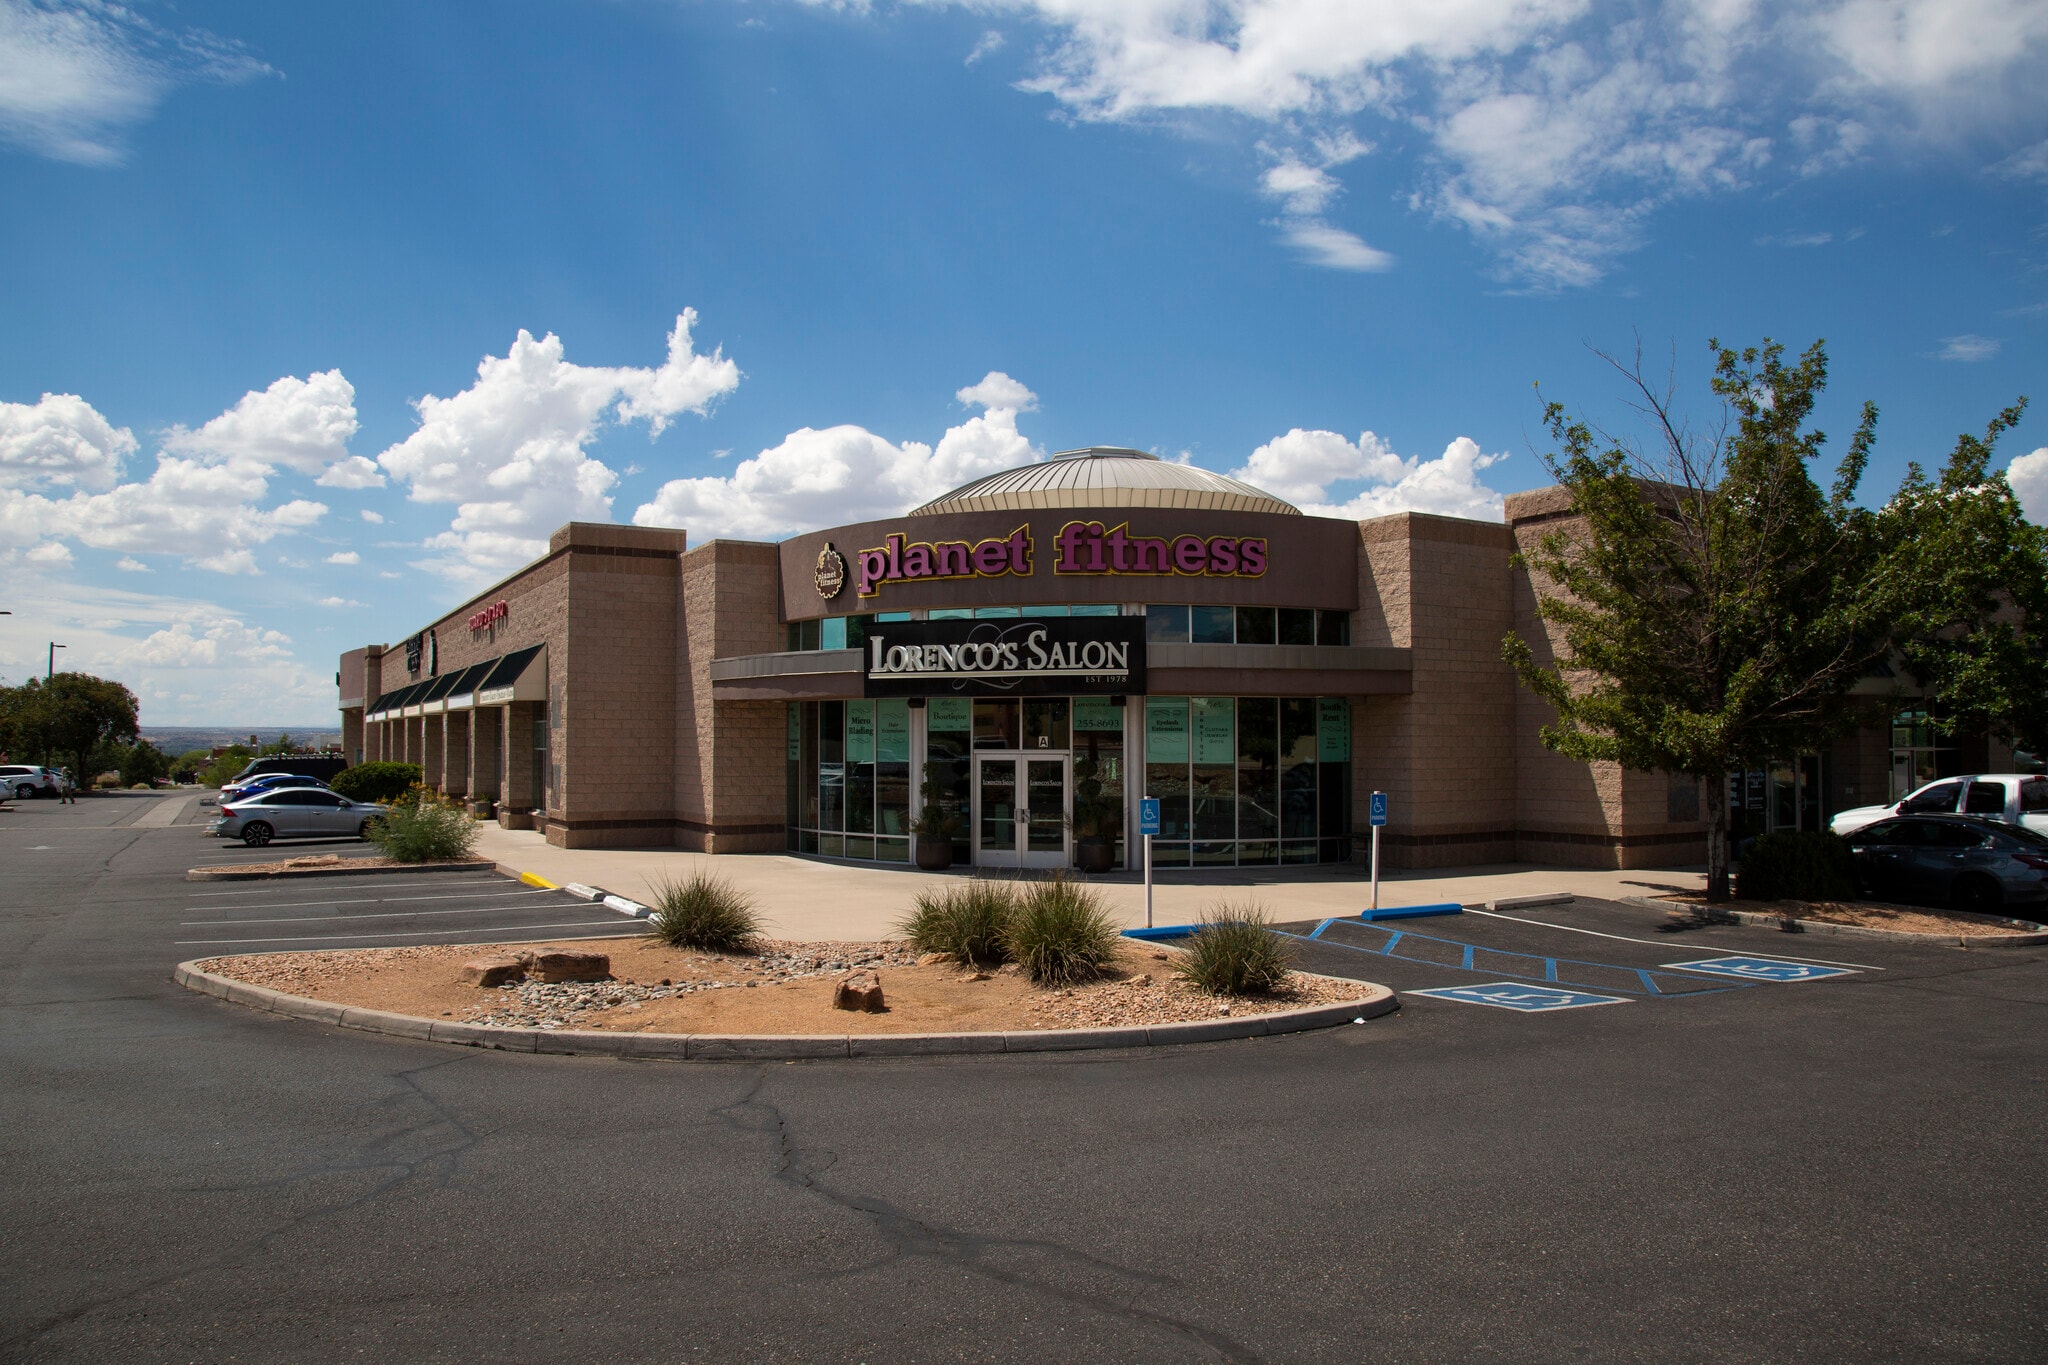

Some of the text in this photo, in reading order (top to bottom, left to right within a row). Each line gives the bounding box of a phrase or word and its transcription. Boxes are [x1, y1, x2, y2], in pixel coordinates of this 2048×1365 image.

[858, 522, 1267, 596] planet fitness
[817, 570, 837, 582] planet
[820, 578, 841, 587] fitness
[870, 630, 1129, 672] LORENCO'S SALON
[1085, 675, 1127, 683] EST 1978
[1320, 703, 1341, 712] Booth
[933, 712, 967, 721] Boutique
[1322, 714, 1340, 722] Rent
[1076, 719, 1120, 728] 255-8693
[848, 726, 873, 736] Blading
[1040, 737, 1047, 746] A
